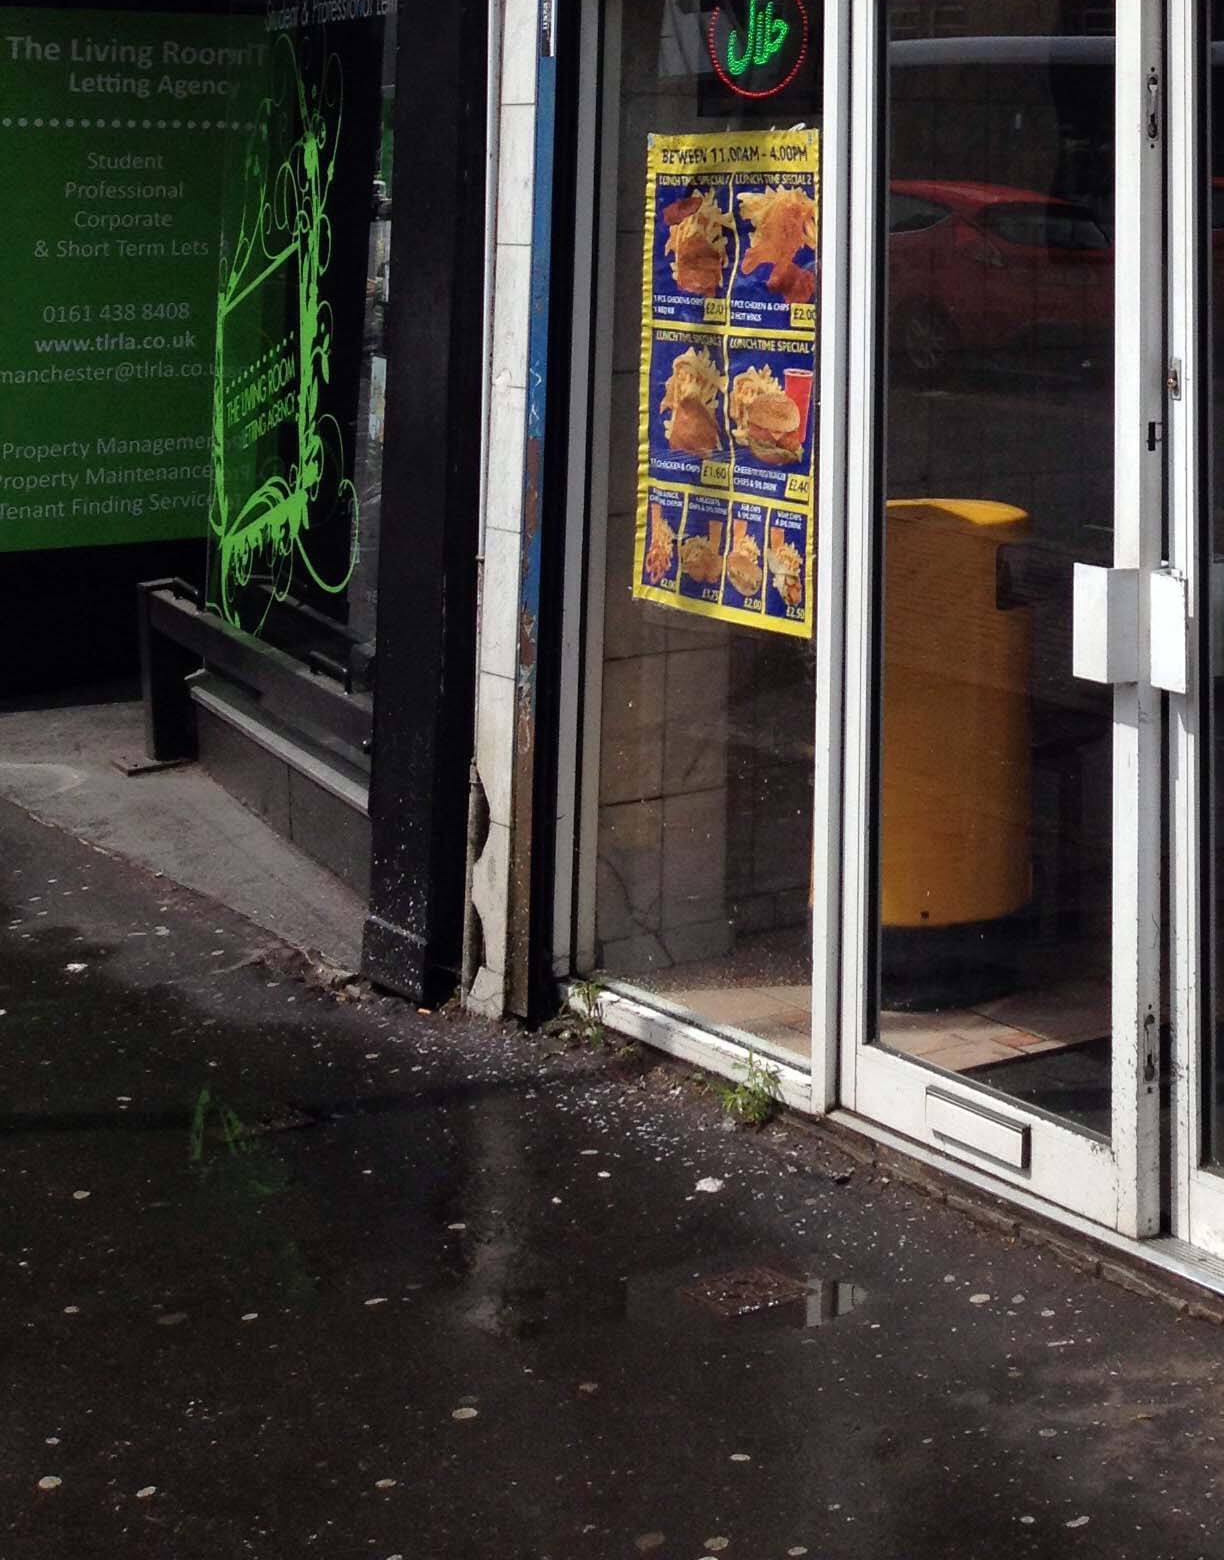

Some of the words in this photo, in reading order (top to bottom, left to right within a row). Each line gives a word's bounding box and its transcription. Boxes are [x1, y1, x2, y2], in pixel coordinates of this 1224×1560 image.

[4, 36, 62, 61] The
[70, 38, 153, 70] Living
[162, 41, 246, 64] Room
[68, 72, 151, 99] Letting
[157, 74, 240, 100] Agency
[87, 152, 164, 170] Student
[661, 147, 707, 165] BETWEEN
[770, 144, 808, 162] 4.00PM
[64, 181, 184, 200] Professional
[74, 210, 174, 231] Corporate
[33, 239, 49, 258] &
[56, 239, 111, 258] Short
[116, 239, 165, 256] Term
[171, 239, 209, 256] Lets
[42, 304, 92, 323] 0161
[99, 303, 136, 322] 438
[141, 302, 191, 321] 8408
[34, 330, 196, 353] www.tlrla.co.uk
[777, 341, 810, 354] SPECIAL
[2, 441, 90, 463] Property
[0, 471, 79, 493] roperty
[86, 462, 213, 486] Maintenance
[72, 495, 144, 517] Finding
